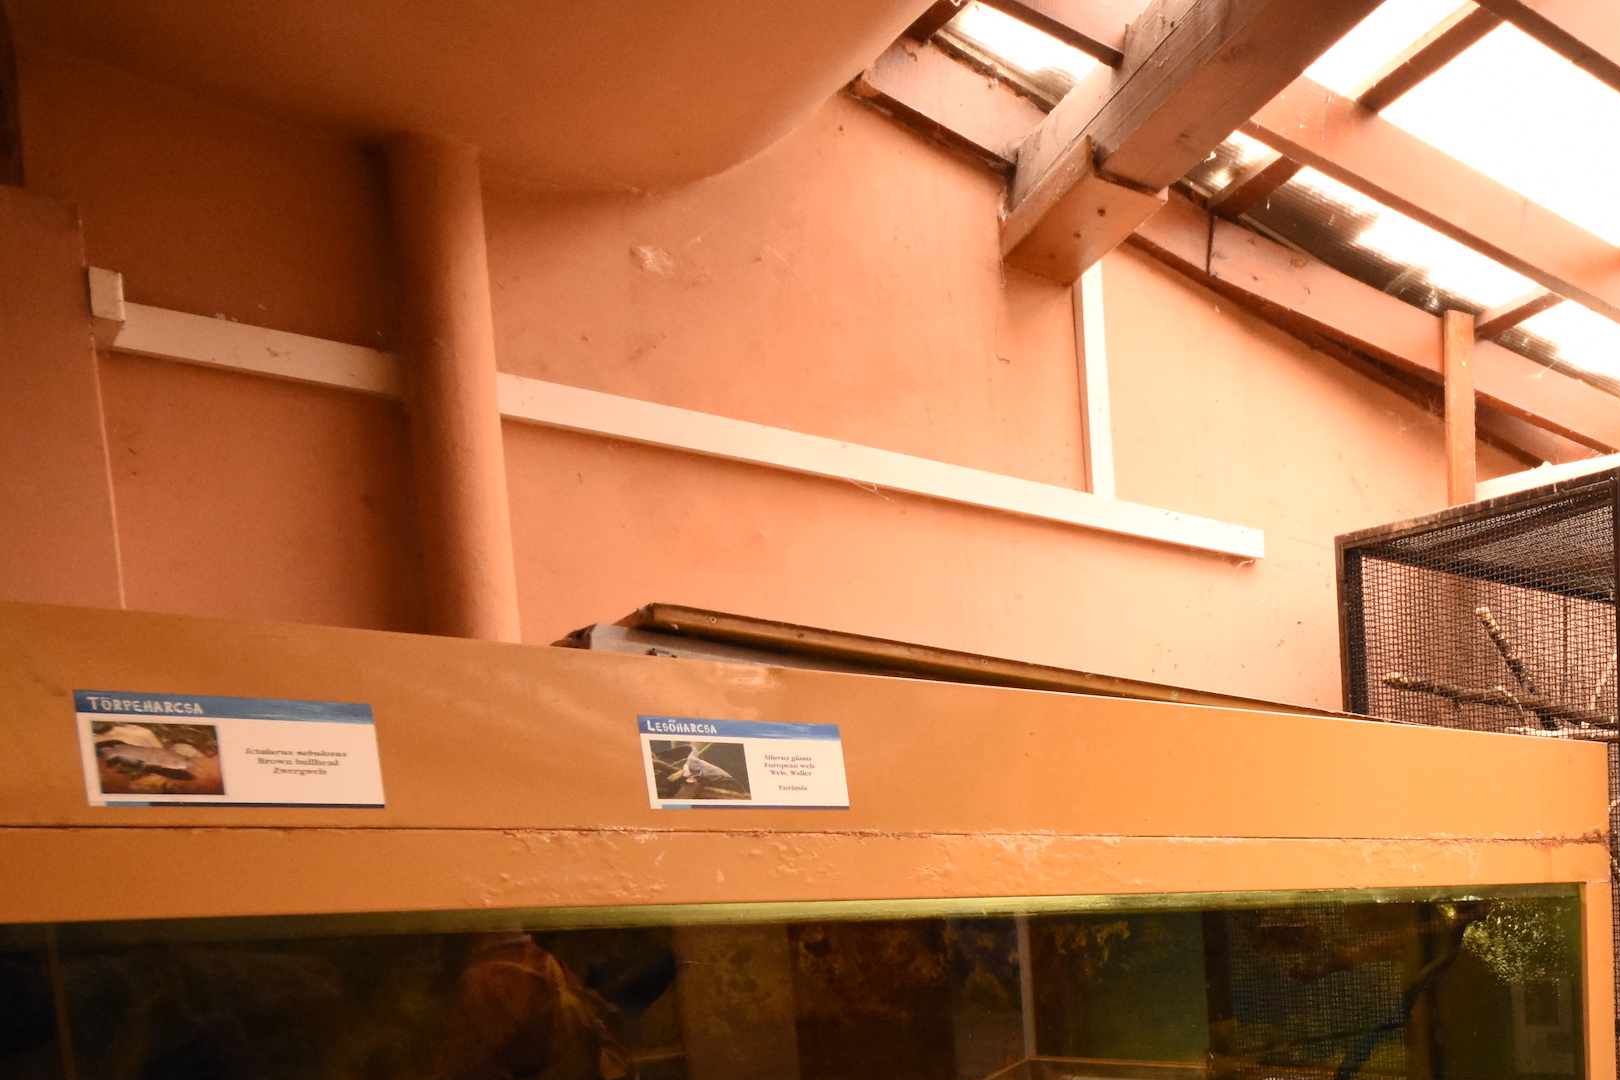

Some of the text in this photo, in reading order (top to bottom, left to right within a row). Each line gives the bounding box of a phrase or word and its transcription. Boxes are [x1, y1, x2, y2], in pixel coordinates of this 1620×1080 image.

[86, 696, 204, 714] TÖRPEHARCSA
[647, 719, 718, 734] LESŐHARCSA
[258, 757, 340, 766] Brown bullhead
